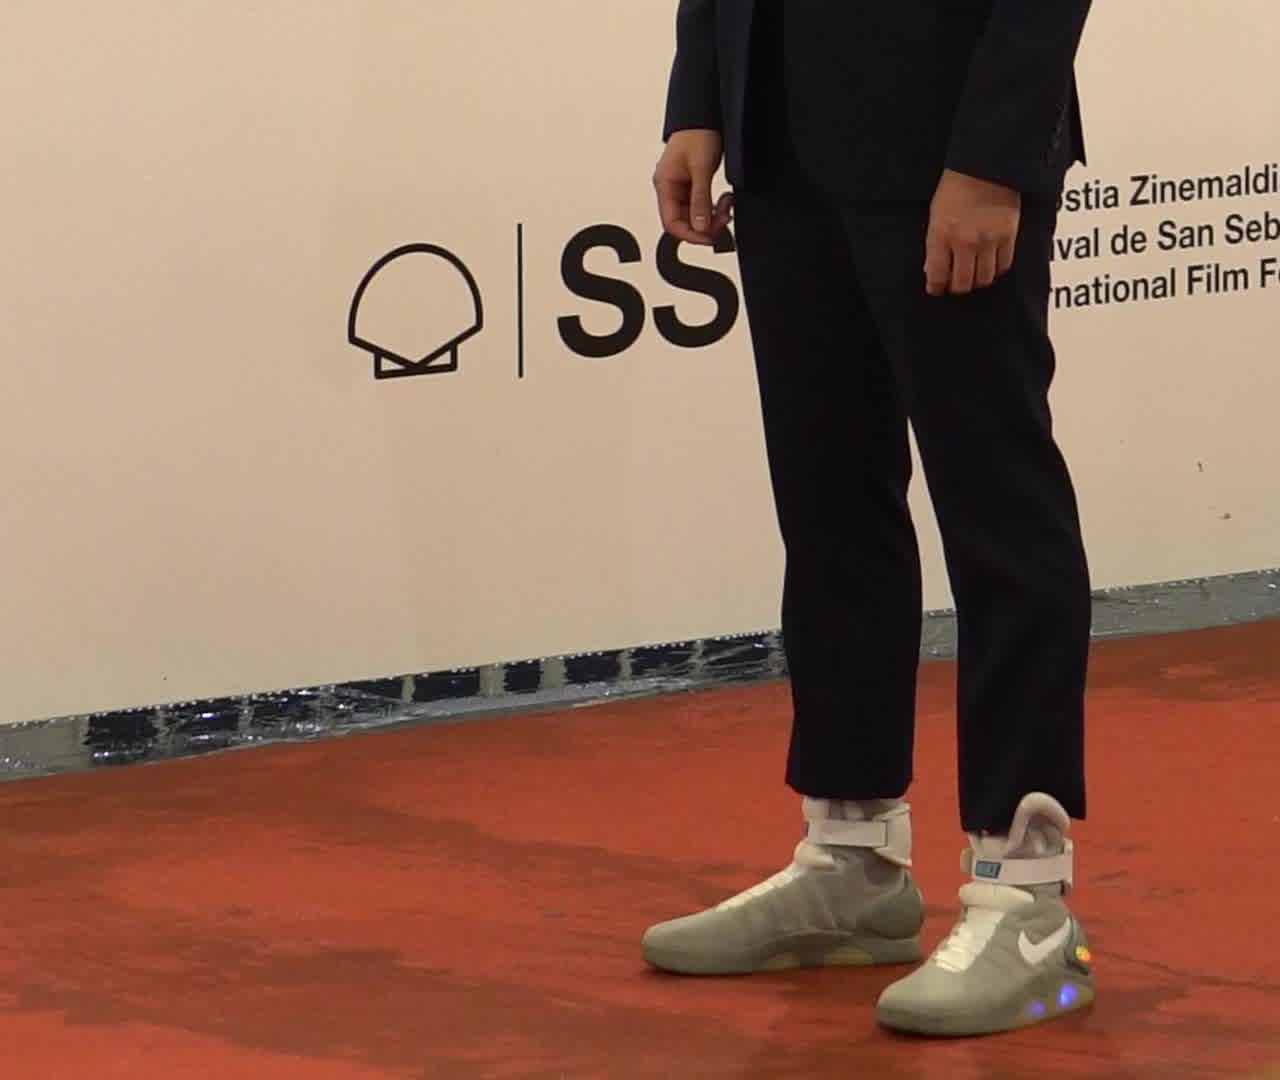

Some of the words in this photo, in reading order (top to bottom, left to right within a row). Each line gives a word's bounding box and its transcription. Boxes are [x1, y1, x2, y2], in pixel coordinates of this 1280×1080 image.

[1056, 179, 1119, 212] stia
[1109, 223, 1148, 257] de
[1156, 219, 1214, 251] San
[1049, 266, 1176, 310] national
[1186, 262, 1250, 296] Film
